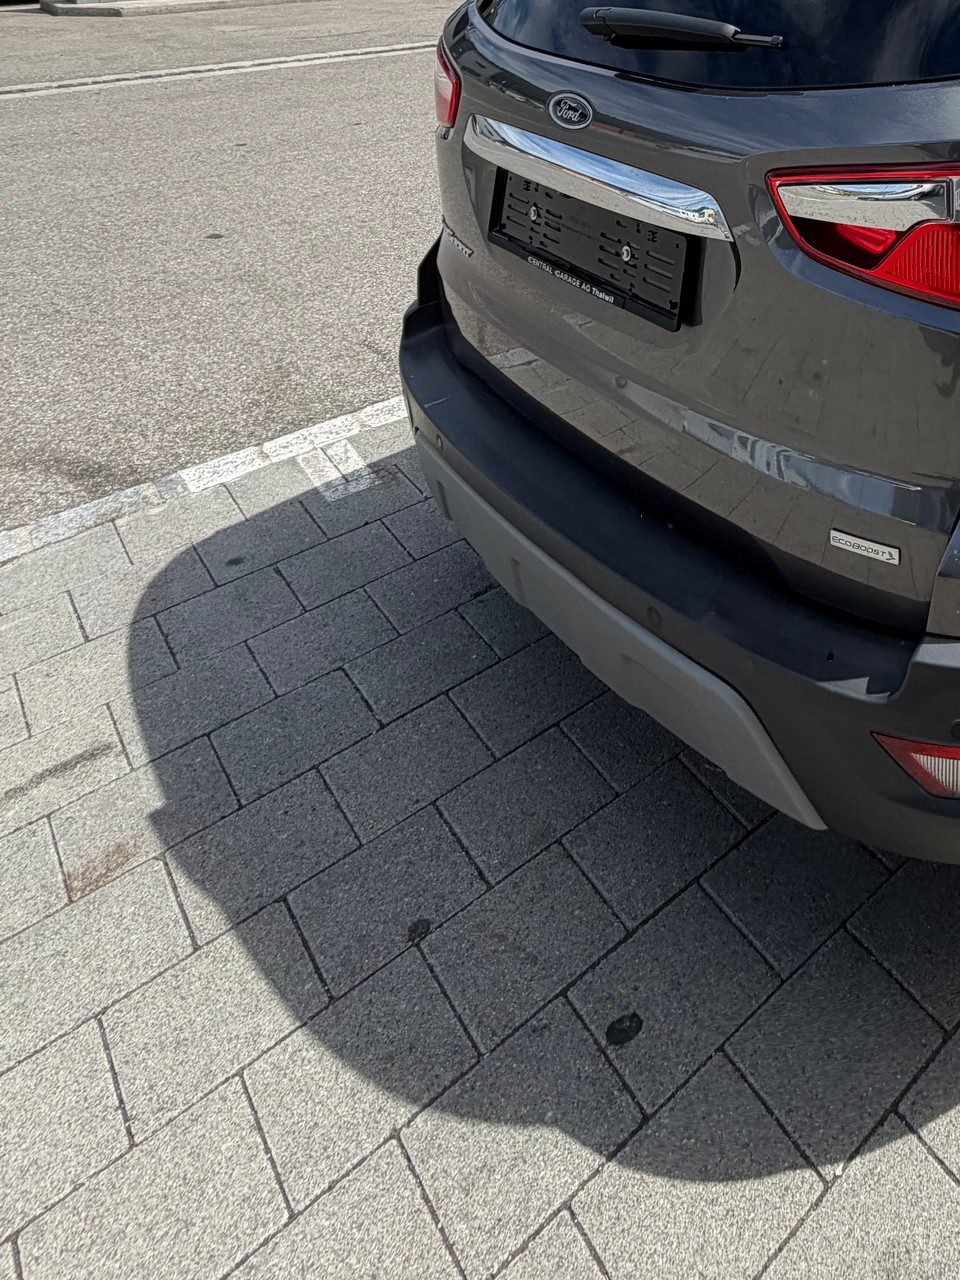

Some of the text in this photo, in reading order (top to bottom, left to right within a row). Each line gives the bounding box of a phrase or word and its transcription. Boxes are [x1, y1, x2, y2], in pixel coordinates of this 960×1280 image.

[556, 98, 582, 123] Ford
[554, 270, 581, 288] GARAGE
[591, 287, 615, 304] Thalwil
[831, 535, 887, 558] ECOBOOST
